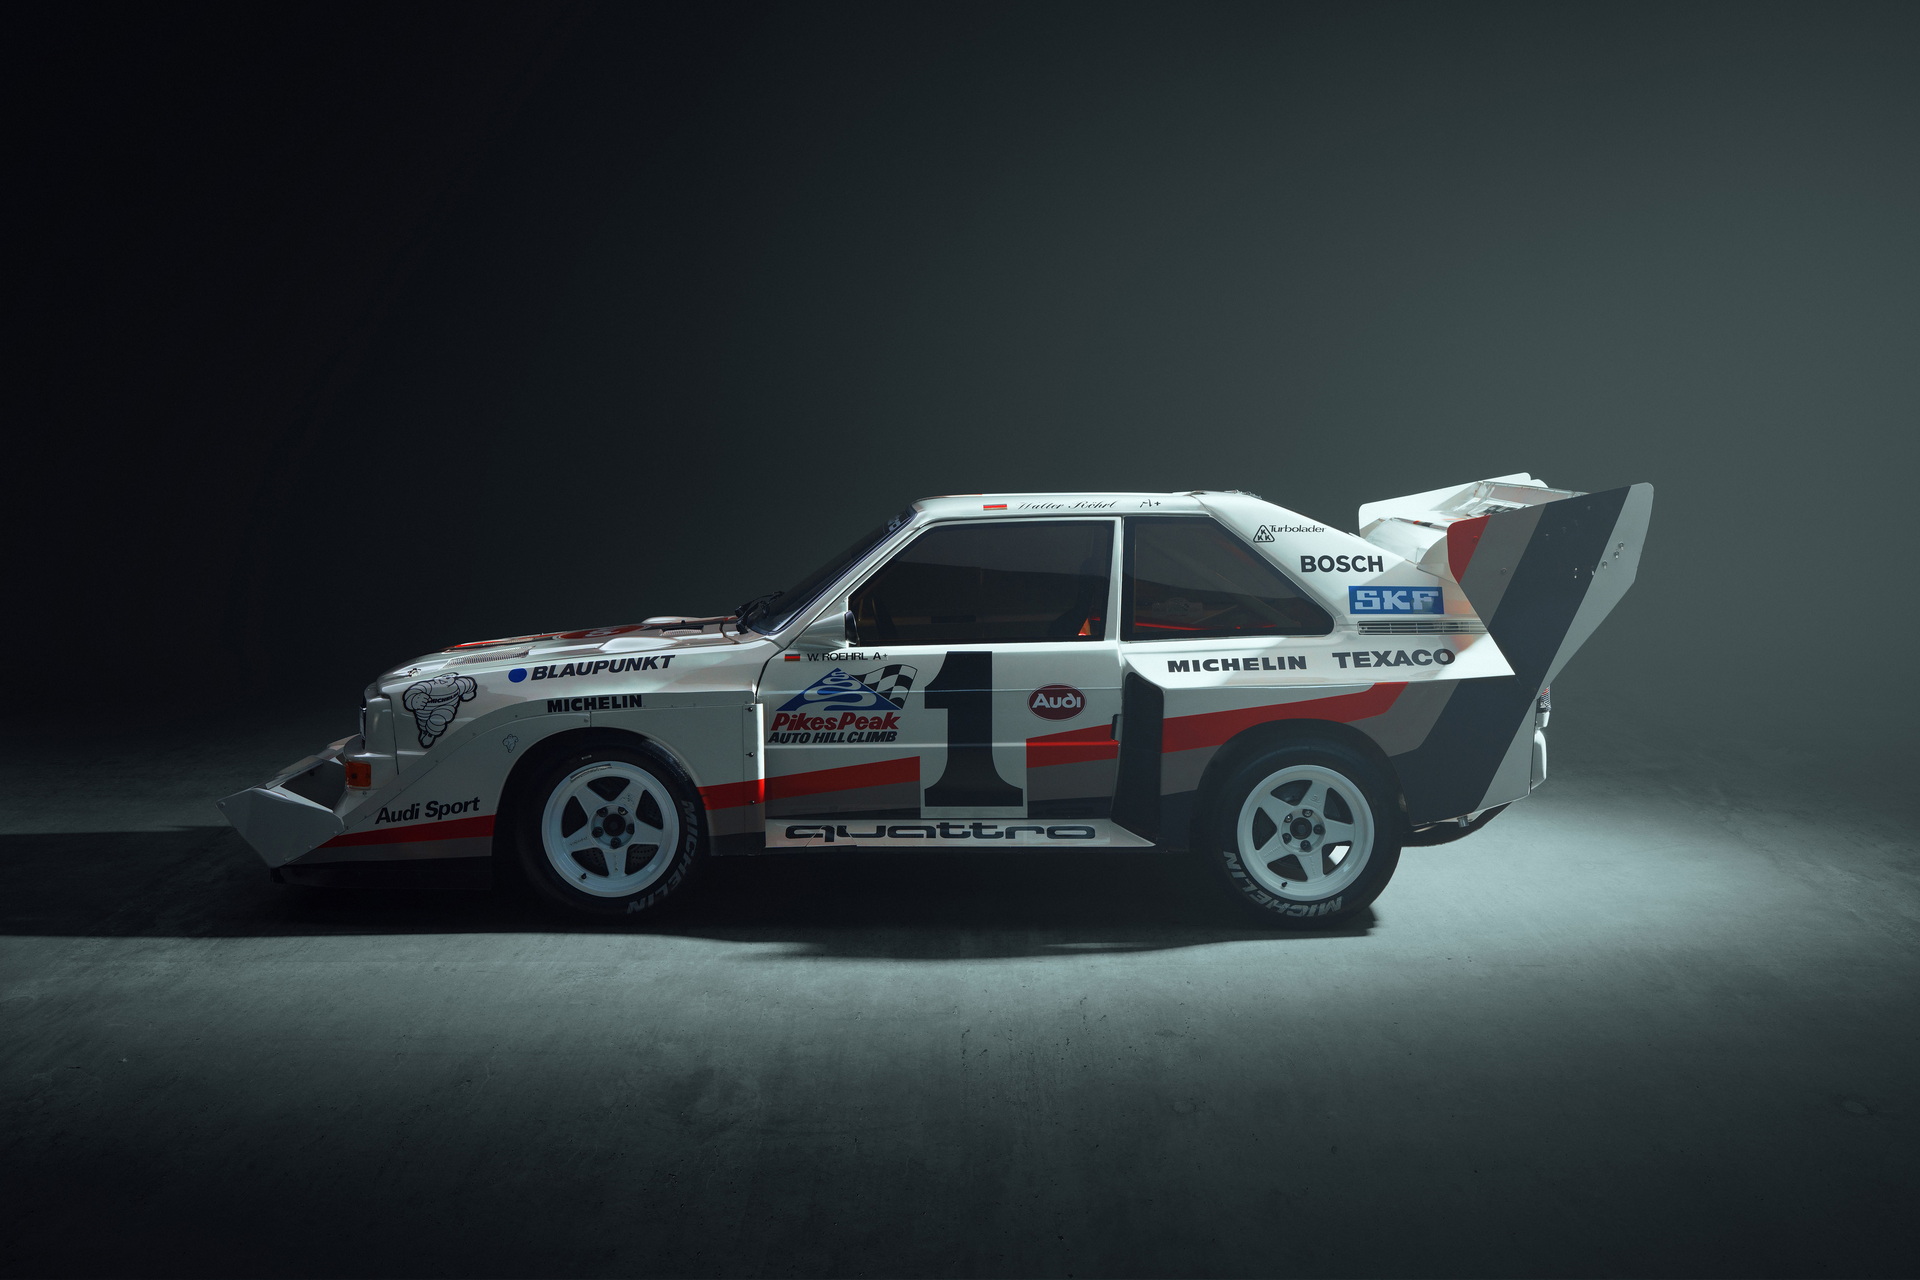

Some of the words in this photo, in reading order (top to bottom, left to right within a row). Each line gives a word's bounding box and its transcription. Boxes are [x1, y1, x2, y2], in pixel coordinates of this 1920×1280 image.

[1269, 525, 1325, 533] Turbolader
[1300, 555, 1384, 573] BOSCH
[1354, 590, 1439, 610] SKF
[807, 653, 819, 662] W.
[822, 652, 868, 661] ROEHRL
[1167, 655, 1307, 673] MICHELIN
[1332, 649, 1455, 669] TEXACO
[531, 654, 676, 681] BLAUPUNKT
[547, 694, 642, 713] MICHELIN
[1031, 692, 1082, 709] Audi
[768, 732, 811, 744] AUTO
[924, 651, 1024, 807] 1
[375, 803, 420, 825] Audi
[424, 796, 480, 820] Sport
[785, 822, 1096, 843] quattro
[626, 800, 698, 914] MICHELIN
[1222, 850, 1343, 917] MICHELIN
